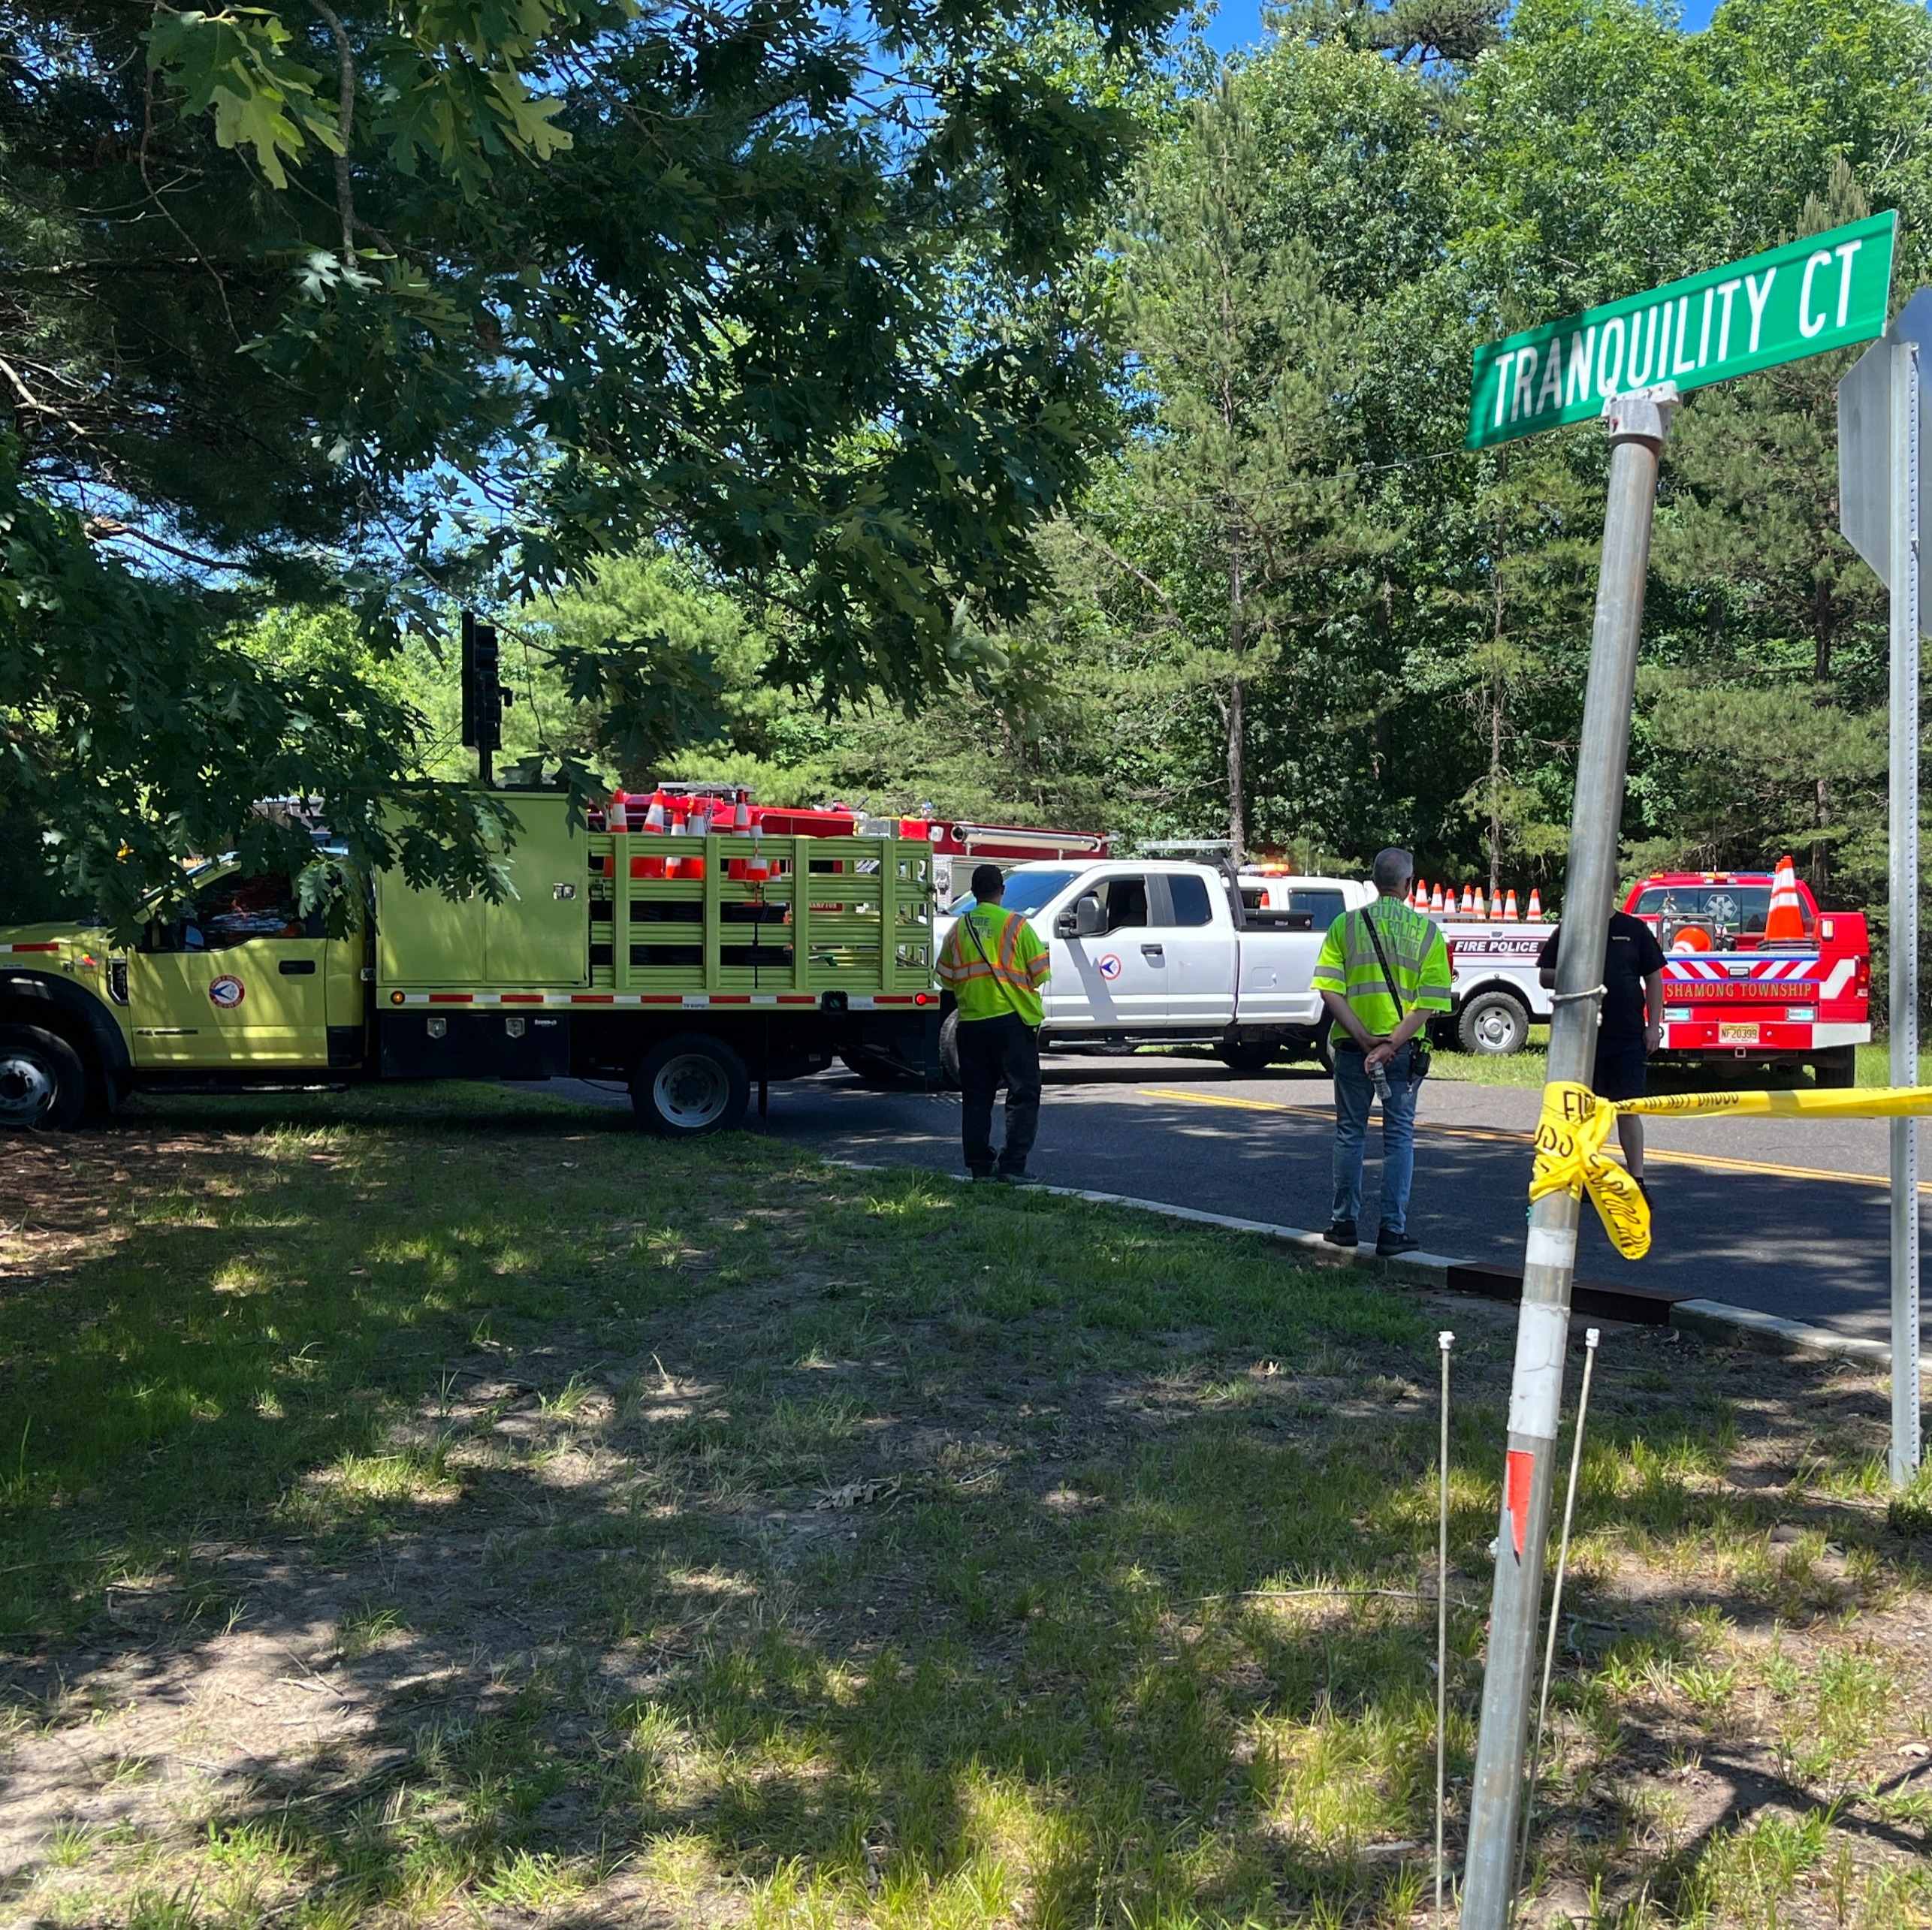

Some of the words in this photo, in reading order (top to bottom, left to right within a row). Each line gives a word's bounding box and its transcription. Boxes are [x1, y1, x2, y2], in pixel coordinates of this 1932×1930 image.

[1495, 268, 1777, 427] TRANQUILITY
[1799, 240, 1862, 339] CT
[1359, 905, 1423, 926] OUNTY
[1454, 941, 1487, 951] FIRE
[1489, 941, 1539, 952] POLICE
[1666, 984, 1734, 997] SHAMONG
[1740, 983, 1812, 997] TOWNSHIP
